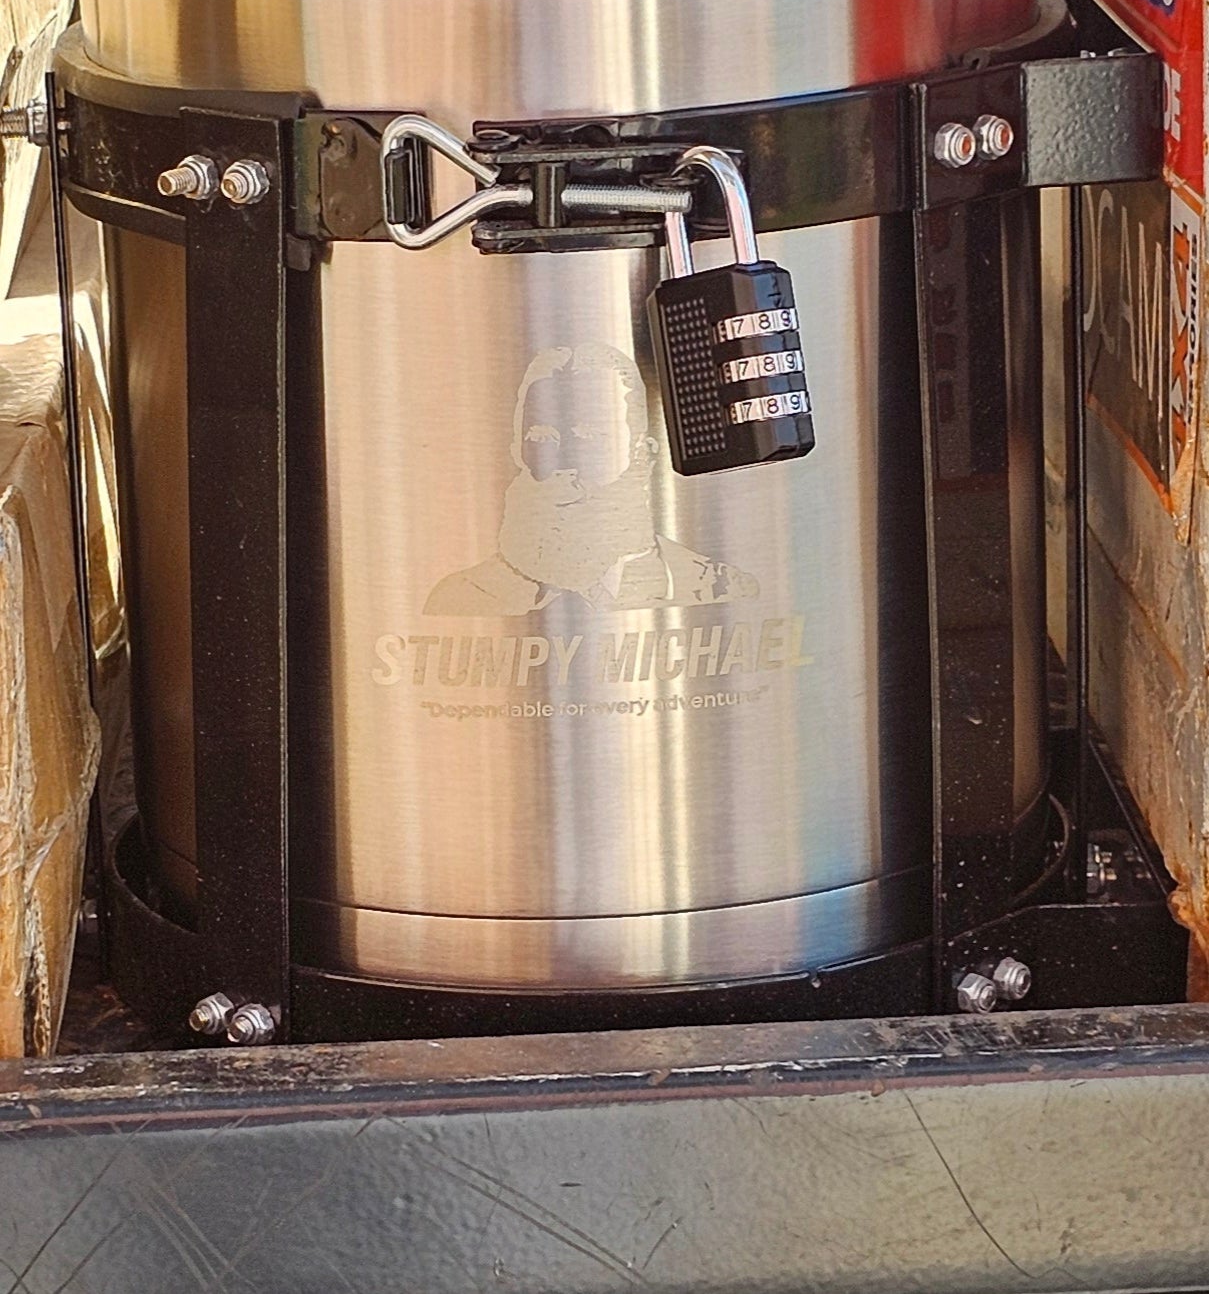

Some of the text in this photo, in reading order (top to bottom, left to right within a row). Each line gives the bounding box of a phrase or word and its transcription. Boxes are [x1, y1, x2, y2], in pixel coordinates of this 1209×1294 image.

[371, 615, 814, 687] STUMPY MICHAEL
[558, 700, 587, 717] for
